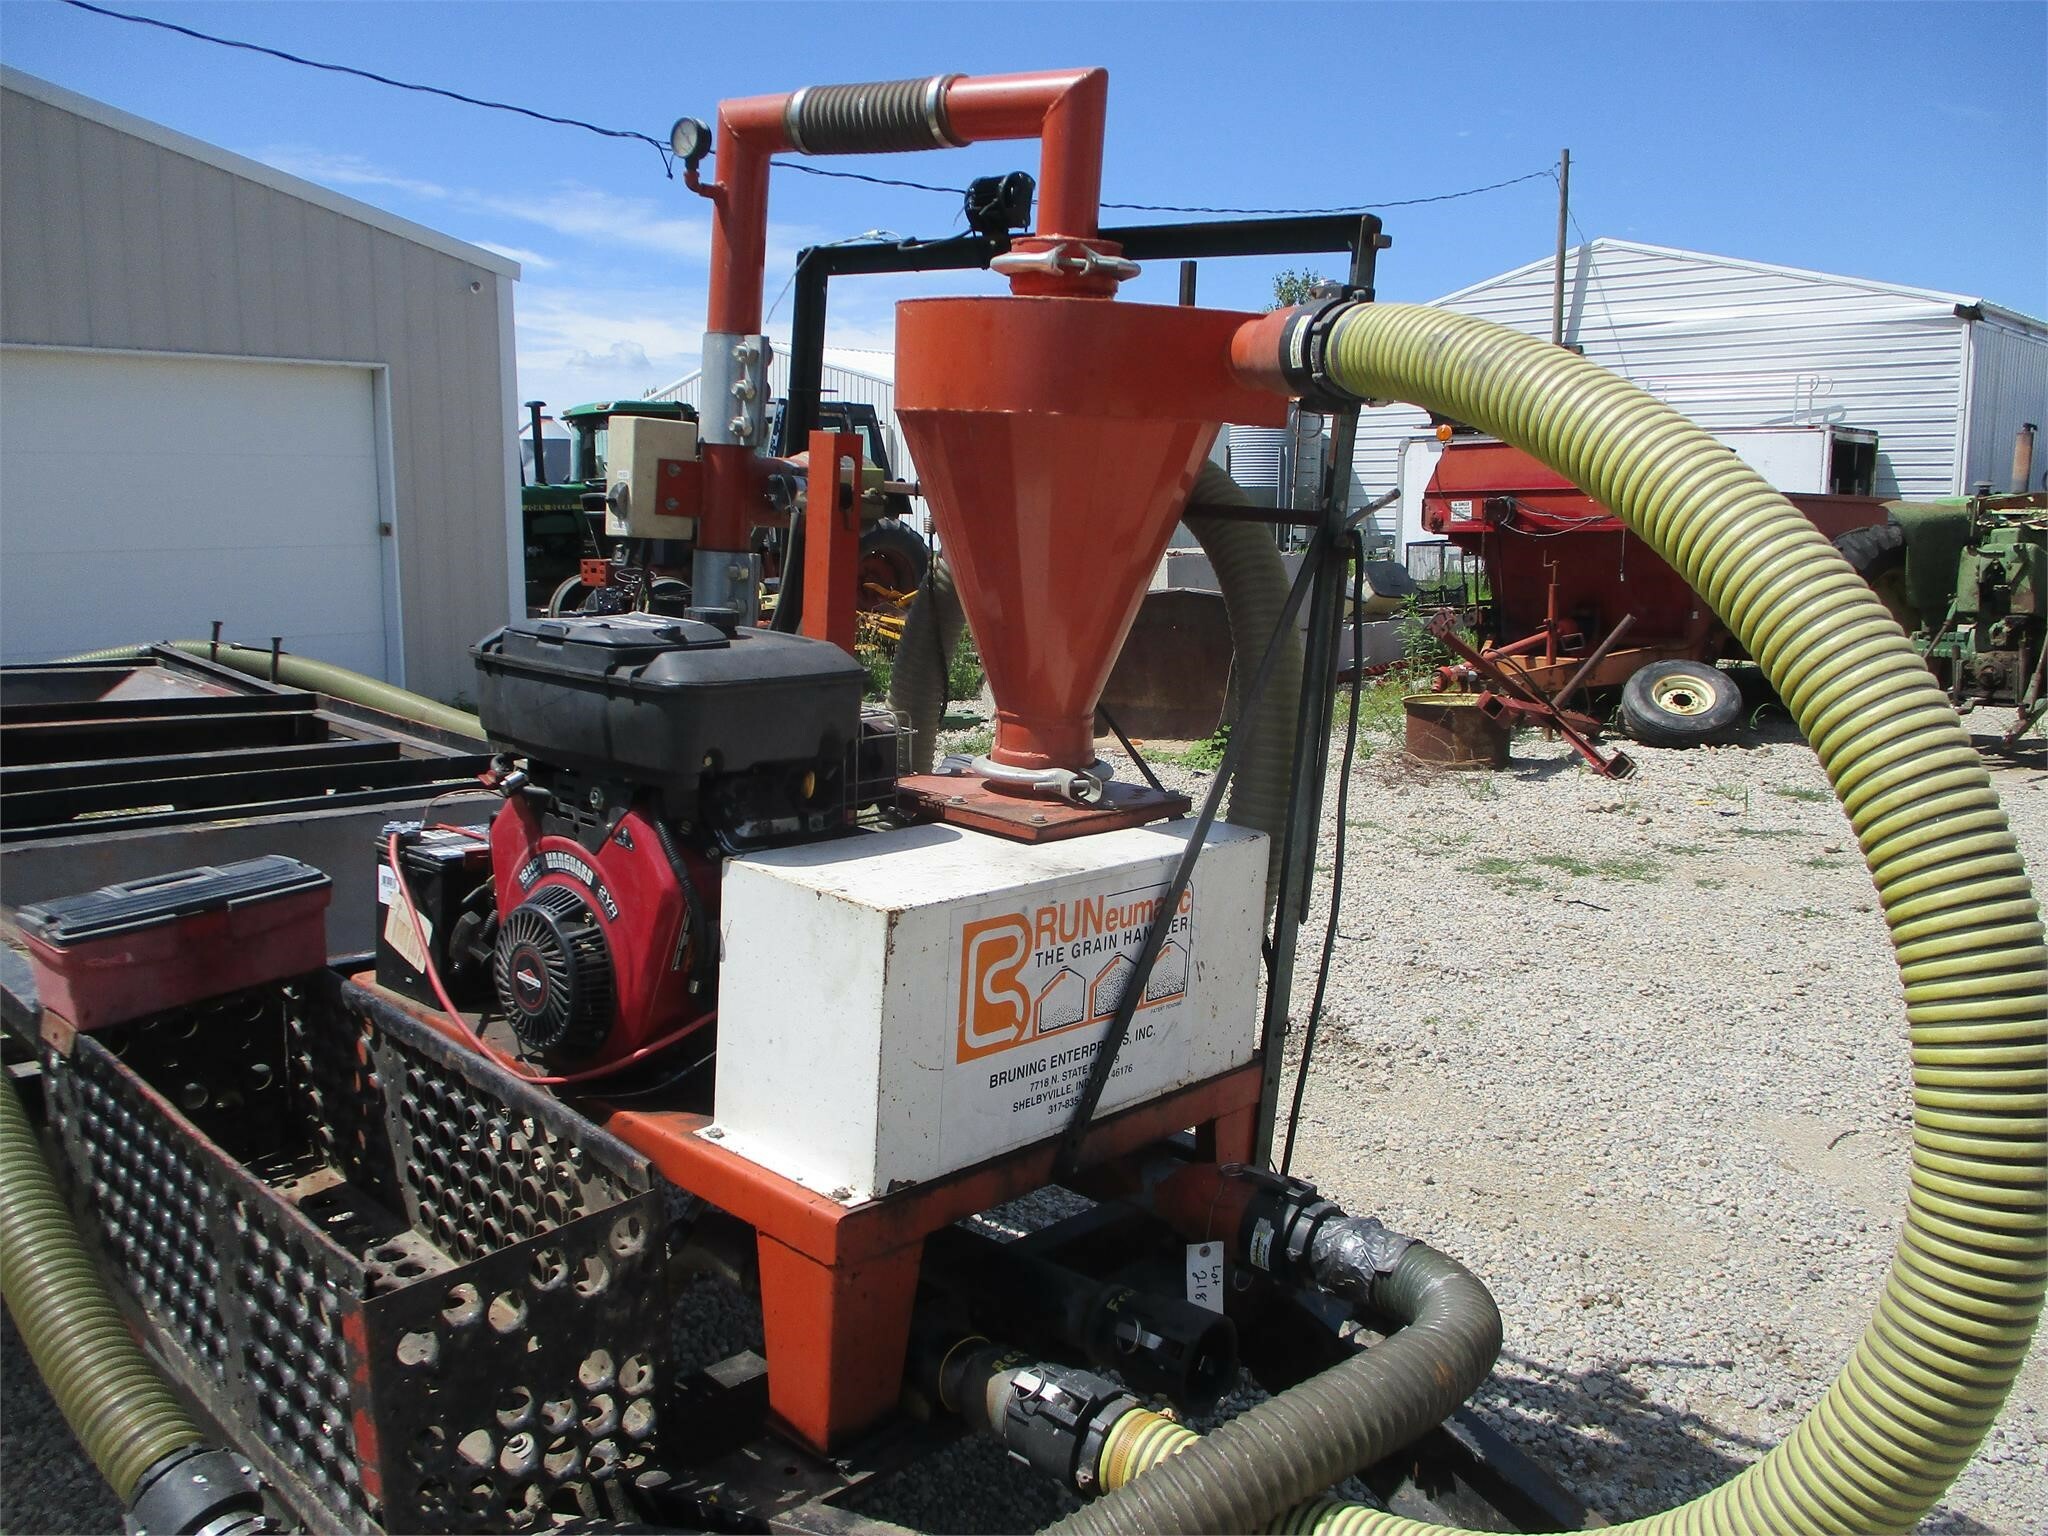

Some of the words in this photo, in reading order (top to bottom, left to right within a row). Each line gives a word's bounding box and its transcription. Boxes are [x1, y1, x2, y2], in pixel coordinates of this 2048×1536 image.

[545, 852, 594, 886] VANGUARD
[1035, 947, 1065, 968] THE
[1071, 934, 1118, 959] GRAIN
[1123, 917, 1188, 946] HANER
[989, 1059, 1047, 1089] BRUNING
[1135, 1024, 1156, 1042] INC.
[1012, 1085, 1074, 1113] SHELBYVILLE,
[1111, 1063, 1133, 1079] 46176
[1030, 1077, 1049, 1092] 7718
[1051, 1076, 1060, 1086] N.
[1061, 1064, 1088, 1082] STATE
[1191, 1270, 1208, 1302] 218
